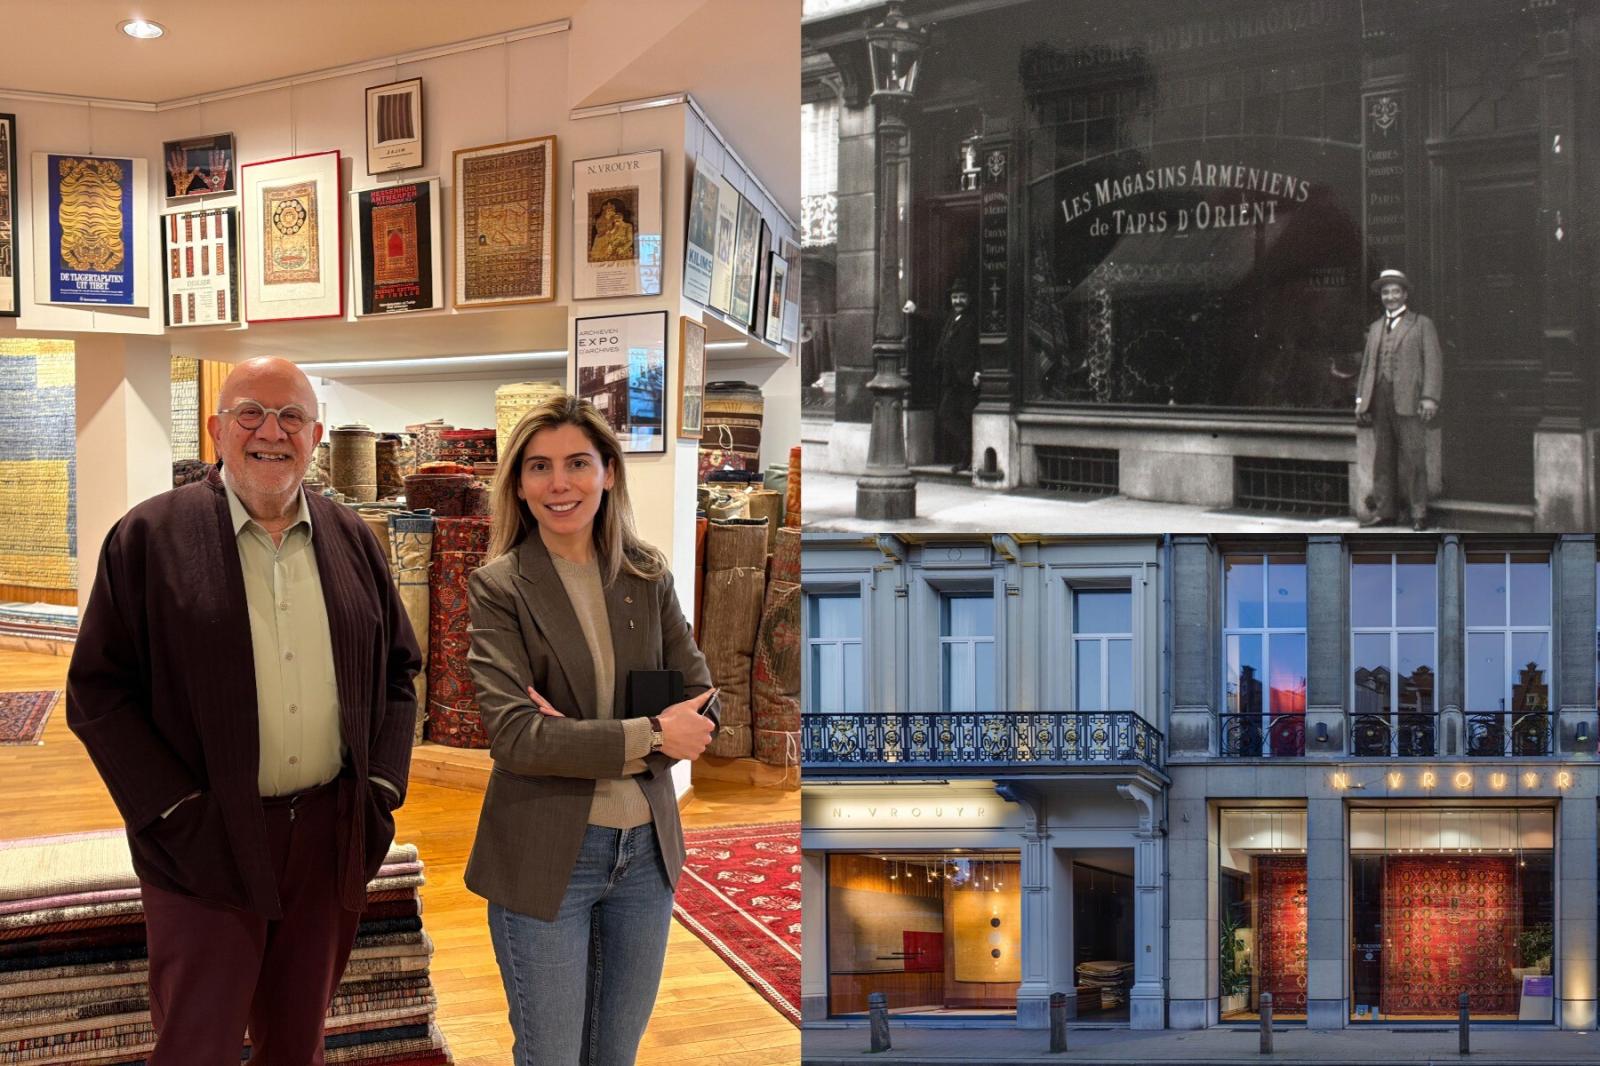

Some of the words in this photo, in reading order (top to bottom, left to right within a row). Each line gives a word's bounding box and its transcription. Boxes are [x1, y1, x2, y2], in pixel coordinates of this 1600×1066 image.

[598, 160, 640, 172] VROUYR
[1061, 191, 1092, 224] LES
[1095, 165, 1187, 207] MAGASINS
[1089, 217, 1109, 237] de
[1112, 209, 1167, 235] TAPIS
[688, 248, 713, 270] KILIMS
[60, 273, 70, 281] DE
[76, 281, 88, 289] UIT
[579, 336, 619, 347] EXPO
[1389, 772, 1571, 788] VROUYR
[832, 807, 851, 818] N.
[867, 807, 985, 818] VROUYR
